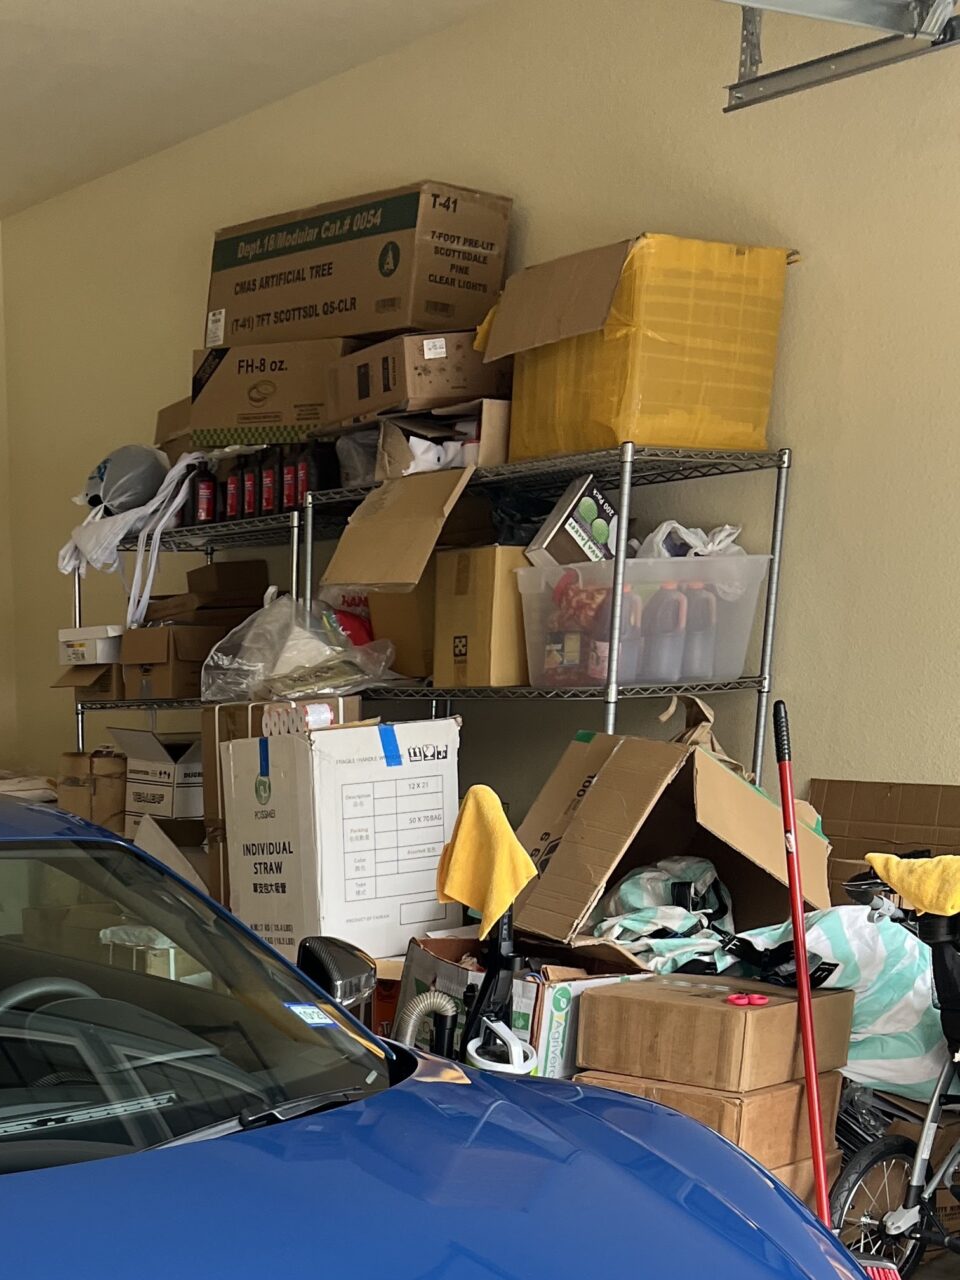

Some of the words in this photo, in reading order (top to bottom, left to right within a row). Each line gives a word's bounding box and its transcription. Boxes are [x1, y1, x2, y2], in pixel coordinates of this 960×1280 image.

[431, 193, 458, 213] T-41
[352, 208, 383, 231] 0054
[431, 230, 461, 245] 7-FOOT
[463, 238, 495, 252] PRE-LIT
[433, 246, 488, 264] SCOTTSDALE
[449, 263, 470, 275] PINE
[234, 279, 257, 296] CMAS
[258, 268, 307, 290] ARTIFICIAL
[309, 262, 333, 280] TREE
[428, 273, 455, 288] CLEAR
[458, 280, 488, 293] LIGHTS
[231, 316, 254, 335] (T-41)
[256, 311, 272, 327] 7FT
[273, 304, 320, 325] SCOTTSDL
[237, 358, 266, 375] FH-8
[269, 359, 288, 372] oz.
[592, 488, 605, 505] Pack
[603, 502, 615, 517] 200
[568, 520, 589, 547] JACKET
[242, 841, 294, 856] INDIVIDUAL
[253, 861, 283, 875] STRAW
